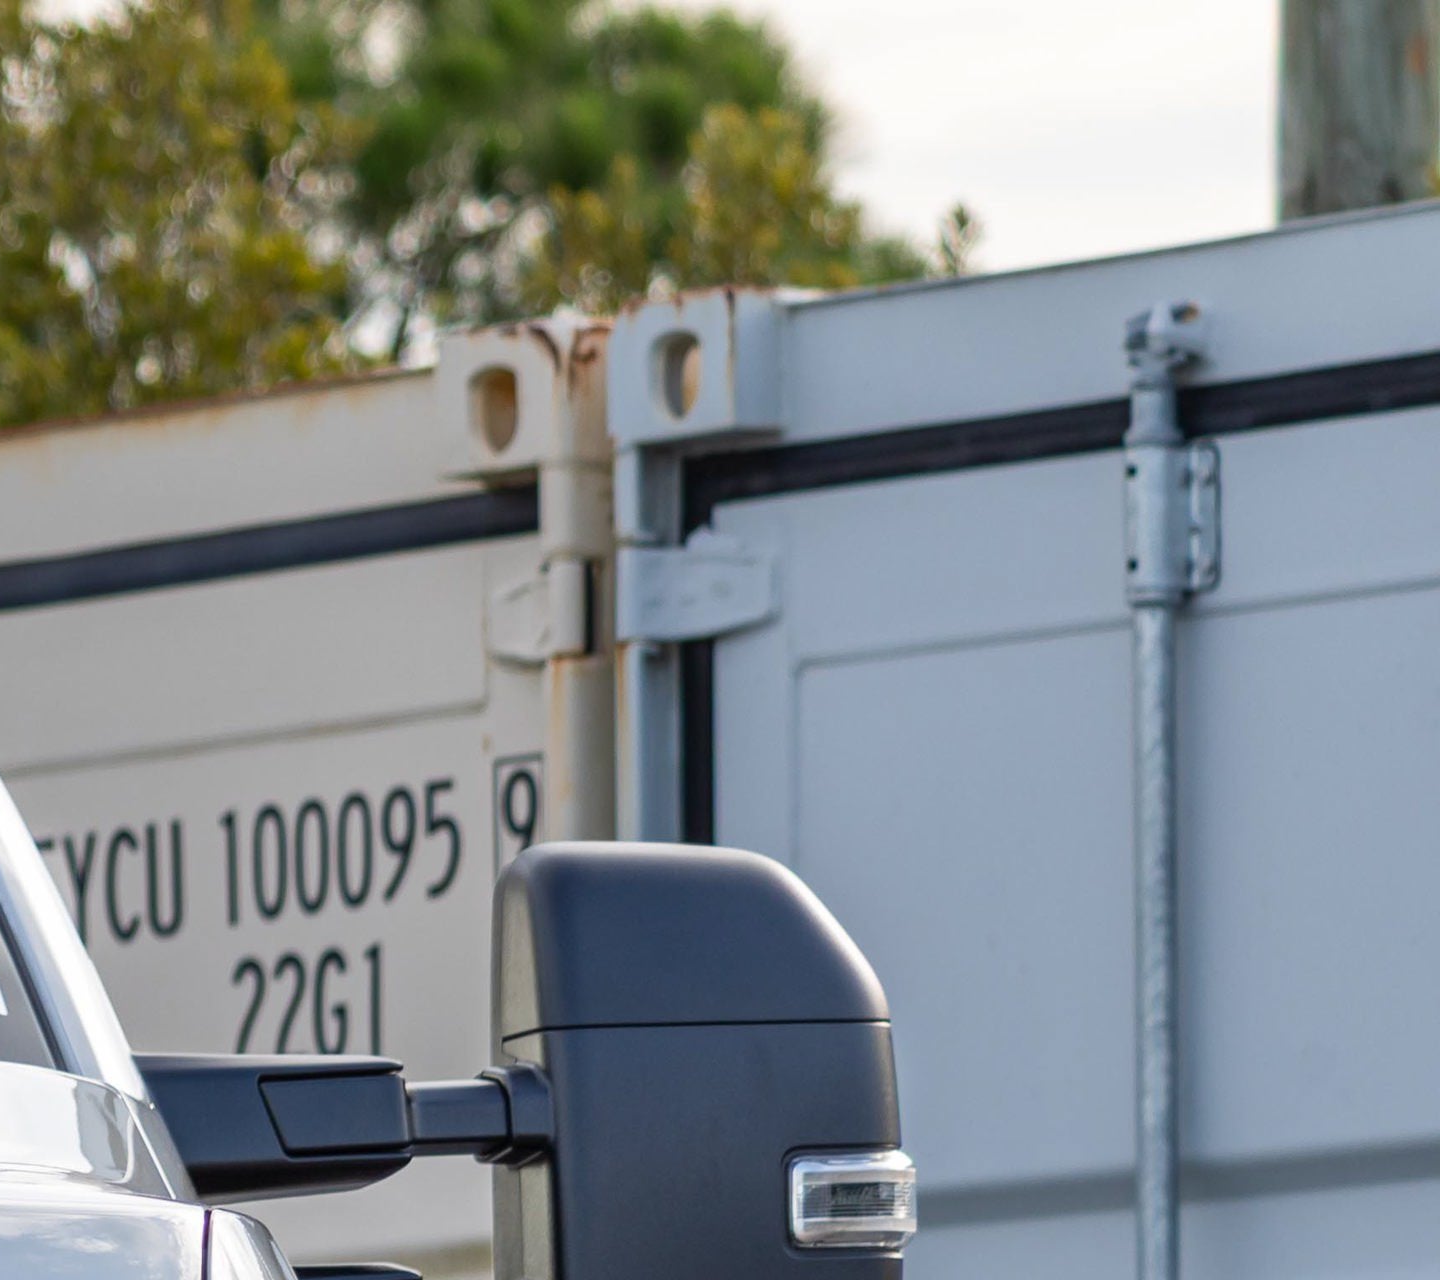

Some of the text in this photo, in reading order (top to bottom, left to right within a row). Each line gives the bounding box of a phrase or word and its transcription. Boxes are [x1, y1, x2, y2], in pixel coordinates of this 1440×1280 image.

[37, 817, 185, 943] YCU
[219, 776, 463, 926] 100095
[232, 942, 384, 1055] 22G1
